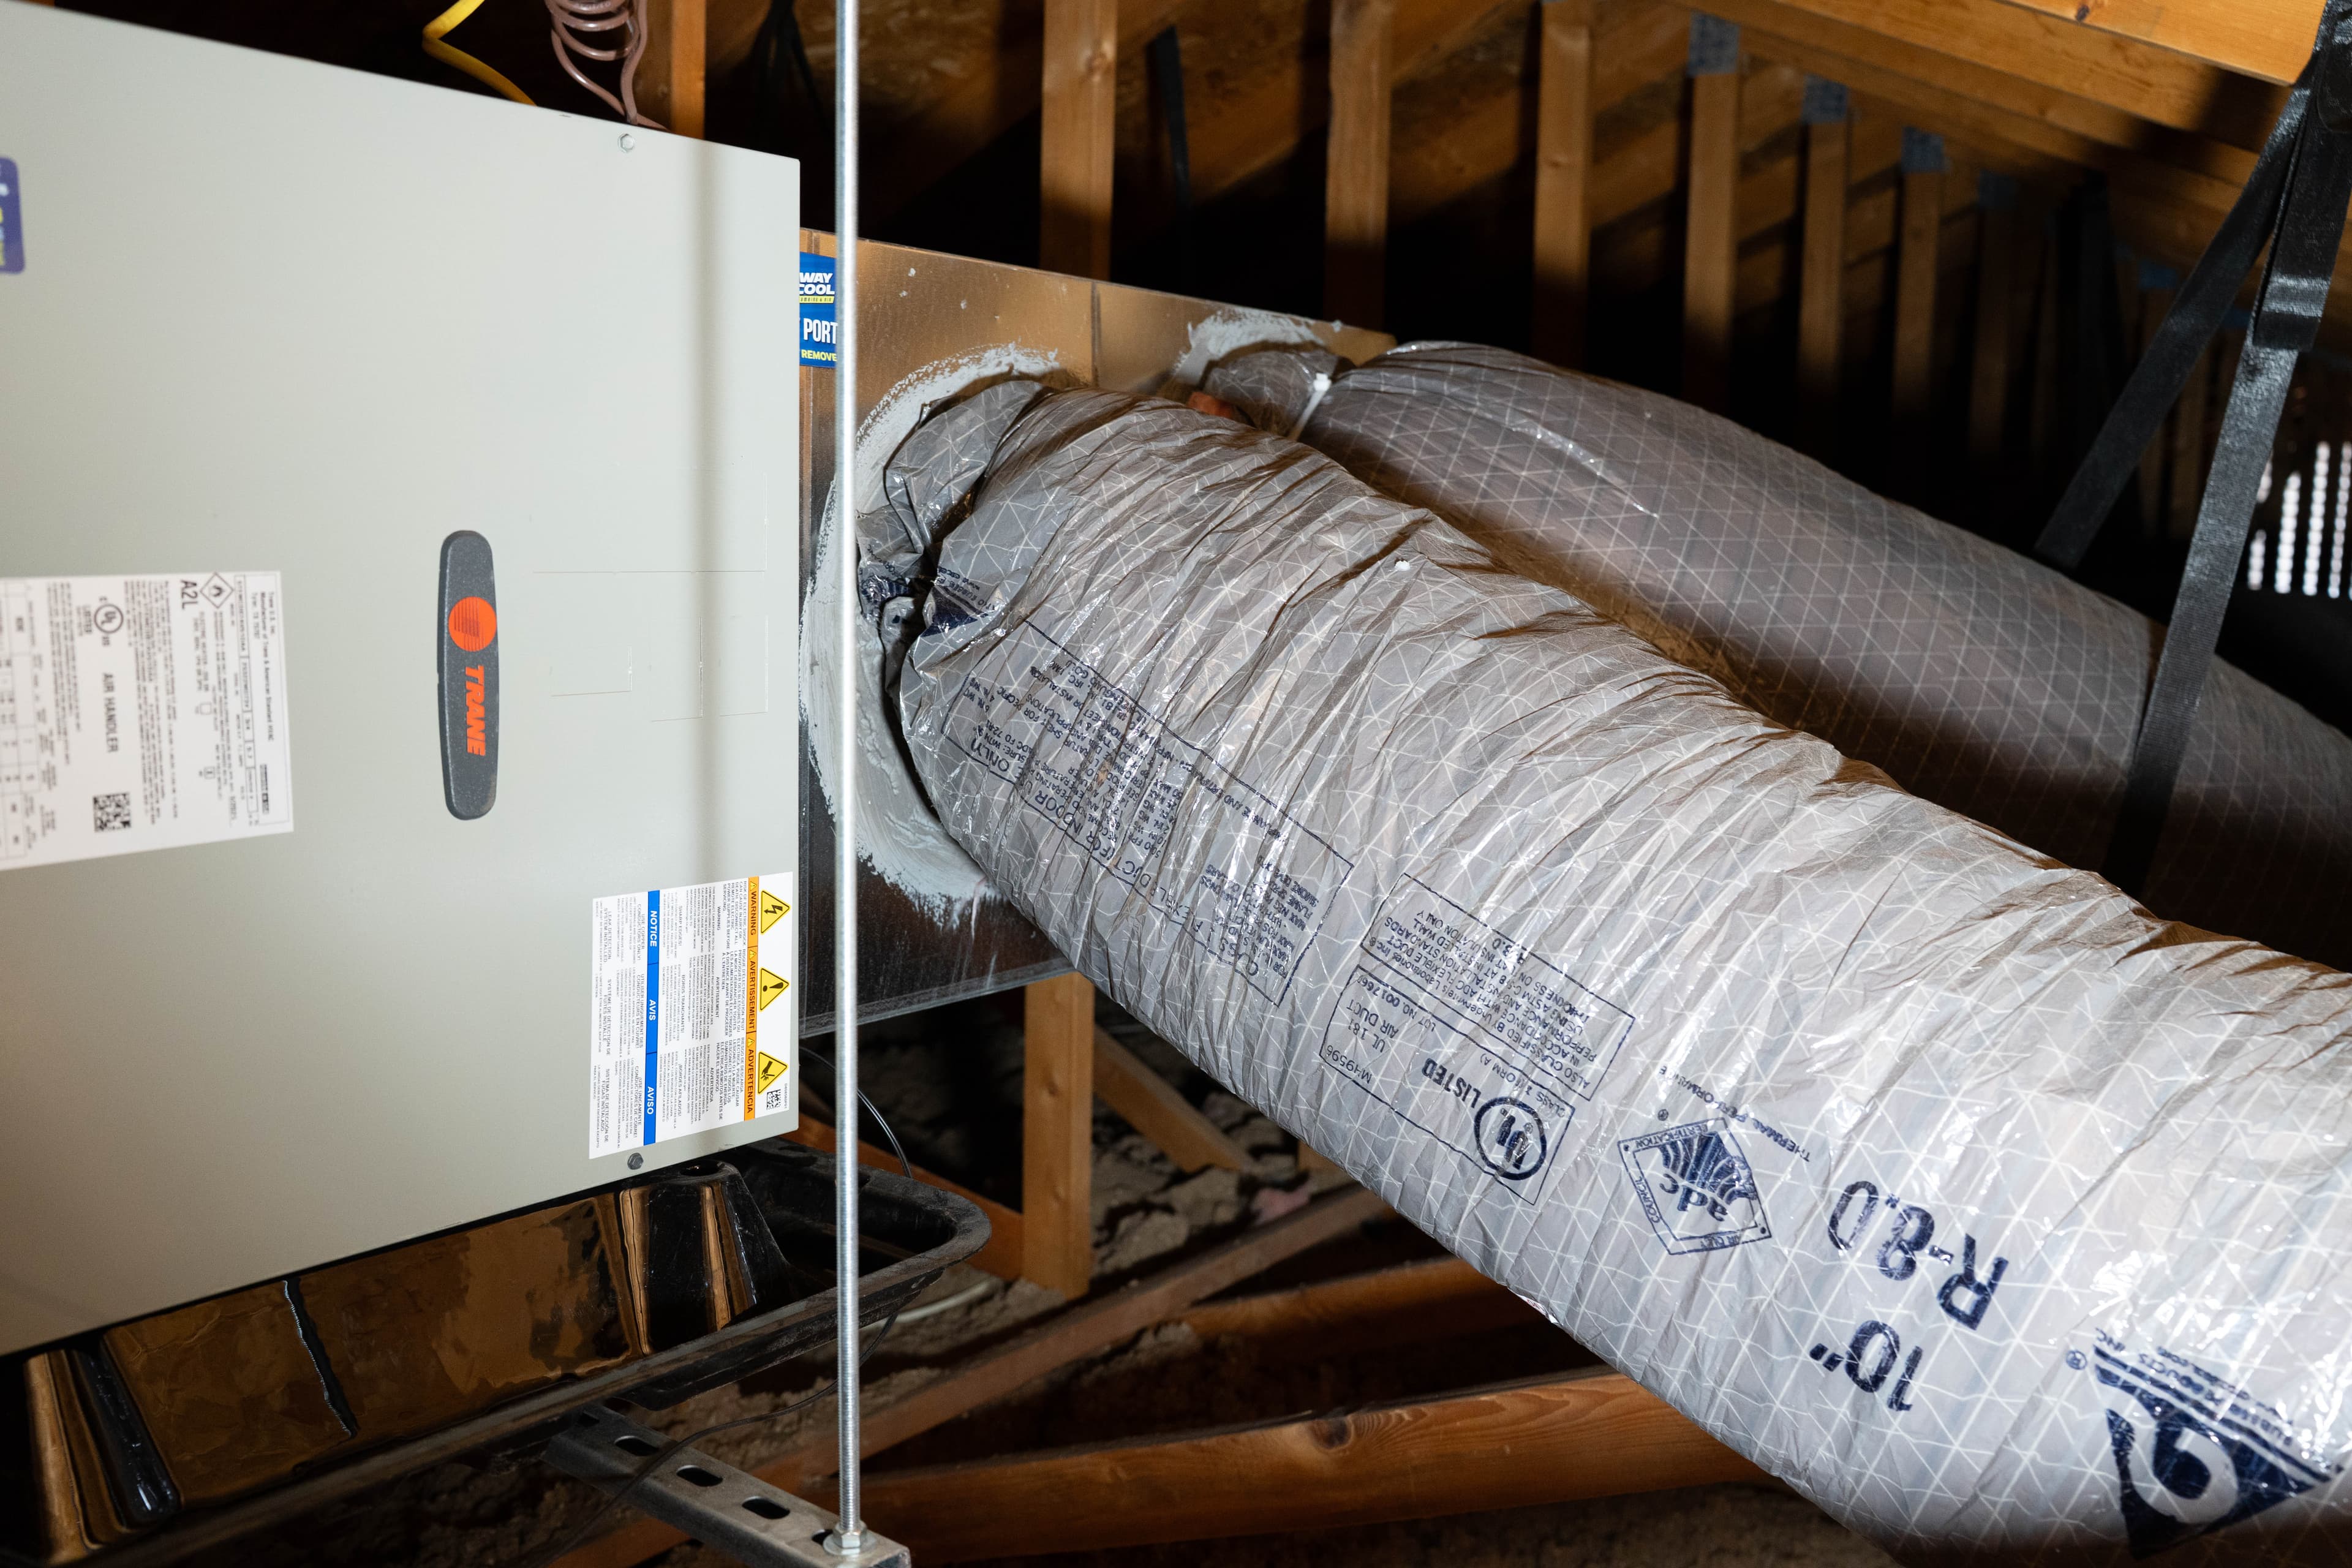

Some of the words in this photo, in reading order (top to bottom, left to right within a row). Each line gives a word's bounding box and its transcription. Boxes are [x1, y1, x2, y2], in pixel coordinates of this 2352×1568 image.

[799, 273, 833, 284] WAY
[804, 318, 839, 344] PORT
[180, 578, 198, 610] A2L
[102, 672, 115, 693] AIR
[466, 664, 486, 756] TRANE
[104, 696, 118, 753] HANDLER
[1483, 965, 1498, 979] AT
[1517, 971, 1534, 986] ON
[1453, 978, 1479, 999] ADC
[1520, 989, 1552, 1014] ASTM
[1344, 998, 1381, 1027] DUCT
[1378, 1019, 1400, 1039] AIR
[1367, 1033, 1389, 1053] UL
[1417, 1056, 1484, 1109] LISTED
[1561, 1066, 1591, 1090] ALSO
[1635, 1175, 1661, 1225] COUNCIL
[1659, 1169, 1727, 1224] adc
[1828, 1180, 2009, 1331] R-8.0
[1809, 1318, 1924, 1412] 10"
